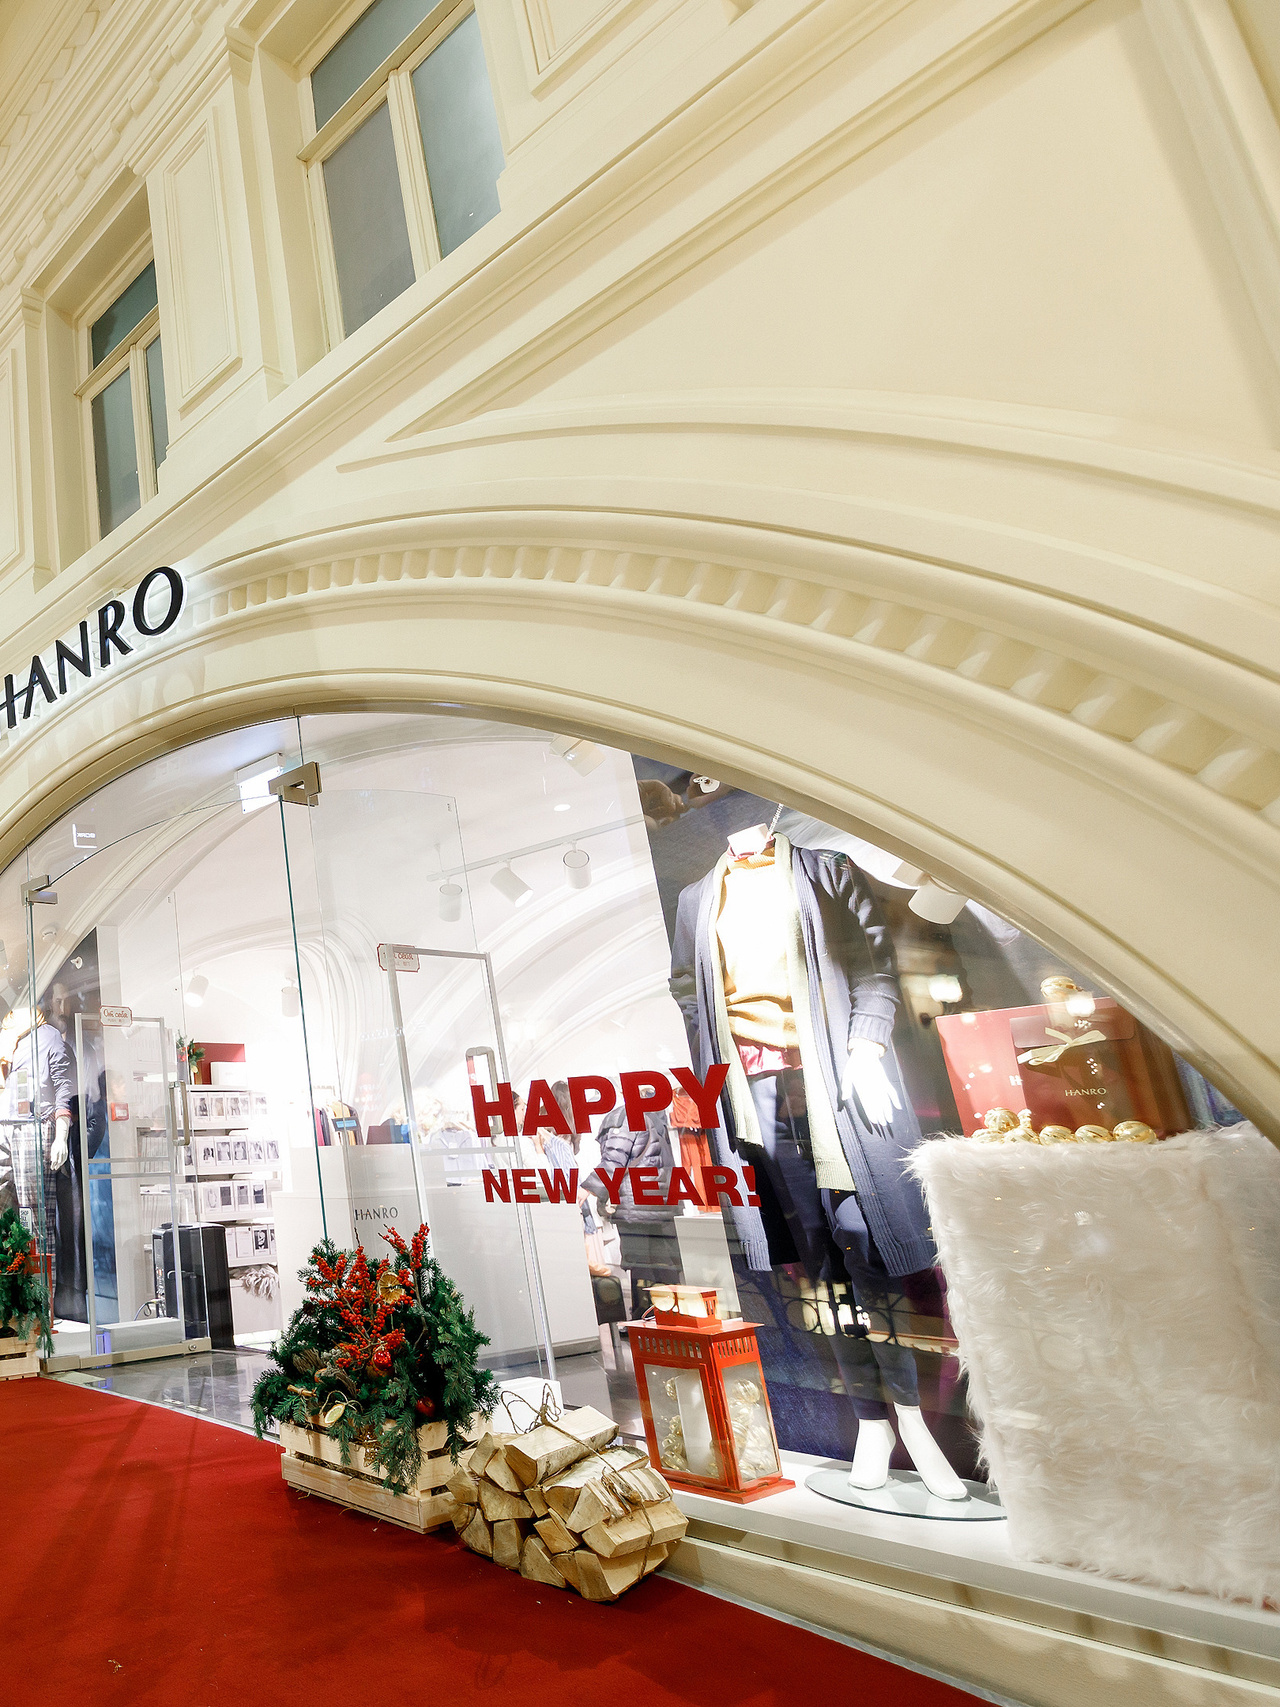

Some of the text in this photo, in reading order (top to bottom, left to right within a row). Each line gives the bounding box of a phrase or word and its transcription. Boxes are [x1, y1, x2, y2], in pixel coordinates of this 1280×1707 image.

[470, 1063, 731, 1138] HAPPY
[1064, 1087, 1107, 1097] HANRO
[481, 1165, 762, 1208] NEW YEAR!
[354, 1206, 399, 1220] HANRO
